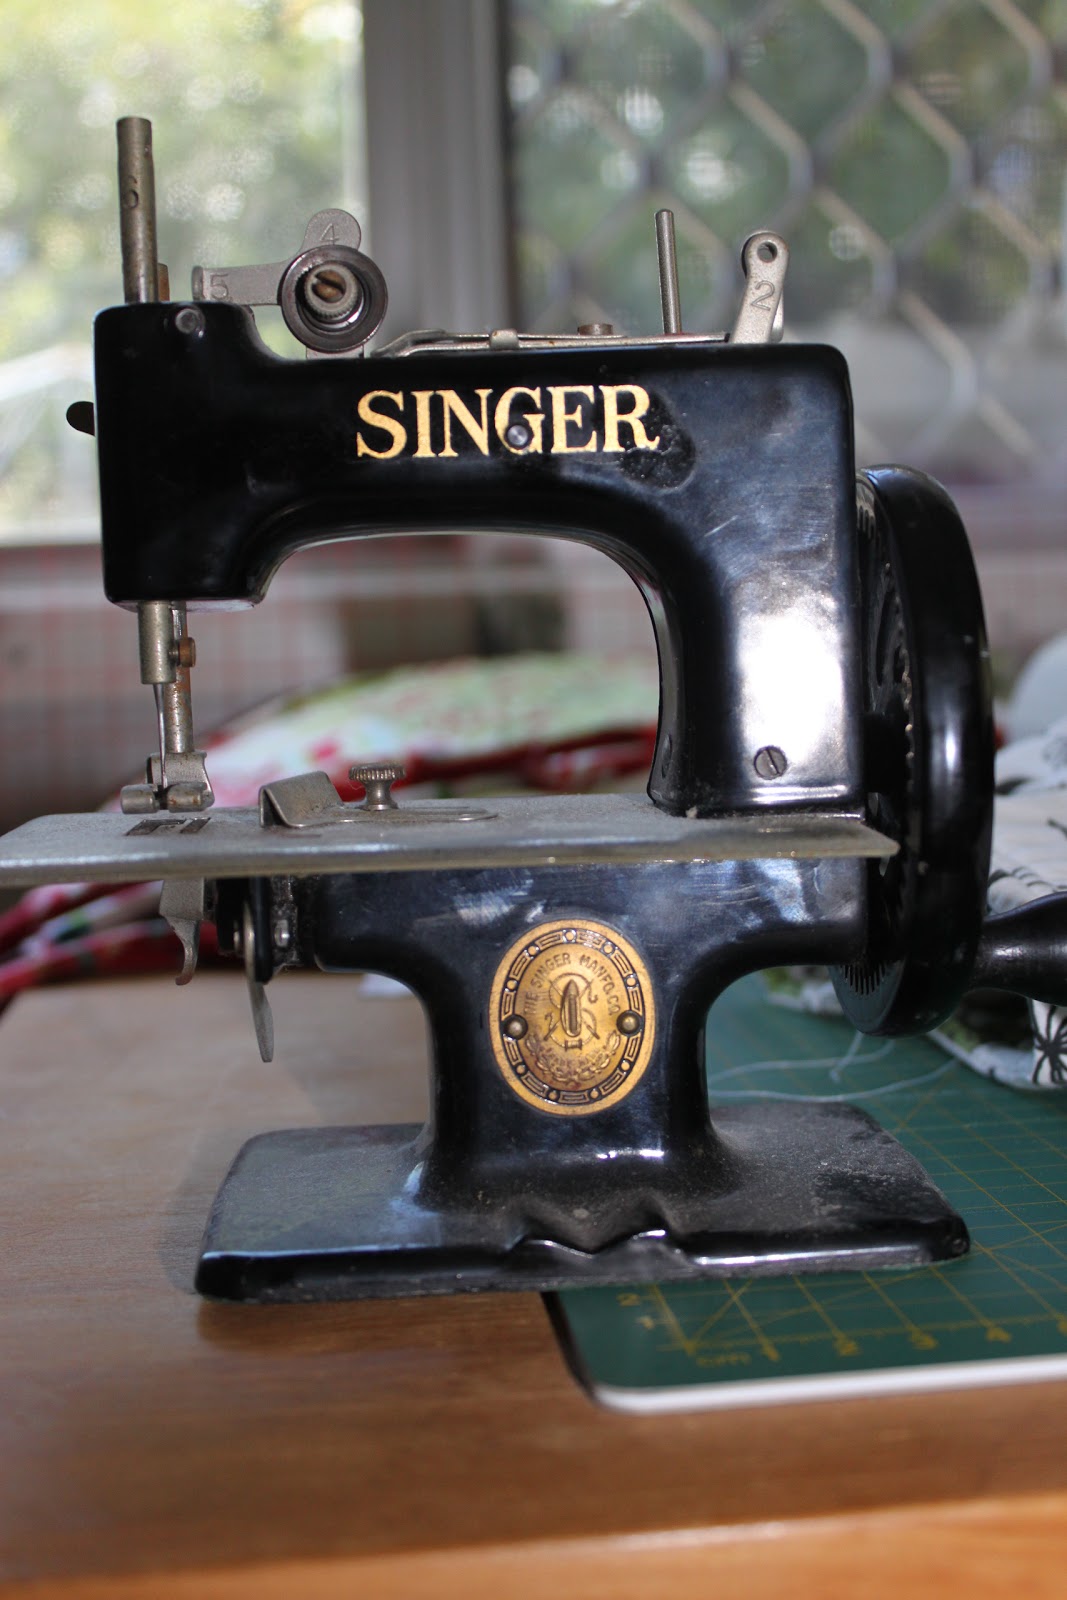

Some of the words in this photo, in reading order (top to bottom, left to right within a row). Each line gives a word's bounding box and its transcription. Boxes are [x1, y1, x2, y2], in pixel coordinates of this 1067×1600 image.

[319, 222, 340, 245] 4
[209, 273, 230, 300] 5
[750, 280, 775, 311] 2
[356, 384, 660, 460] SINGER
[531, 953, 571, 988] SINGER
